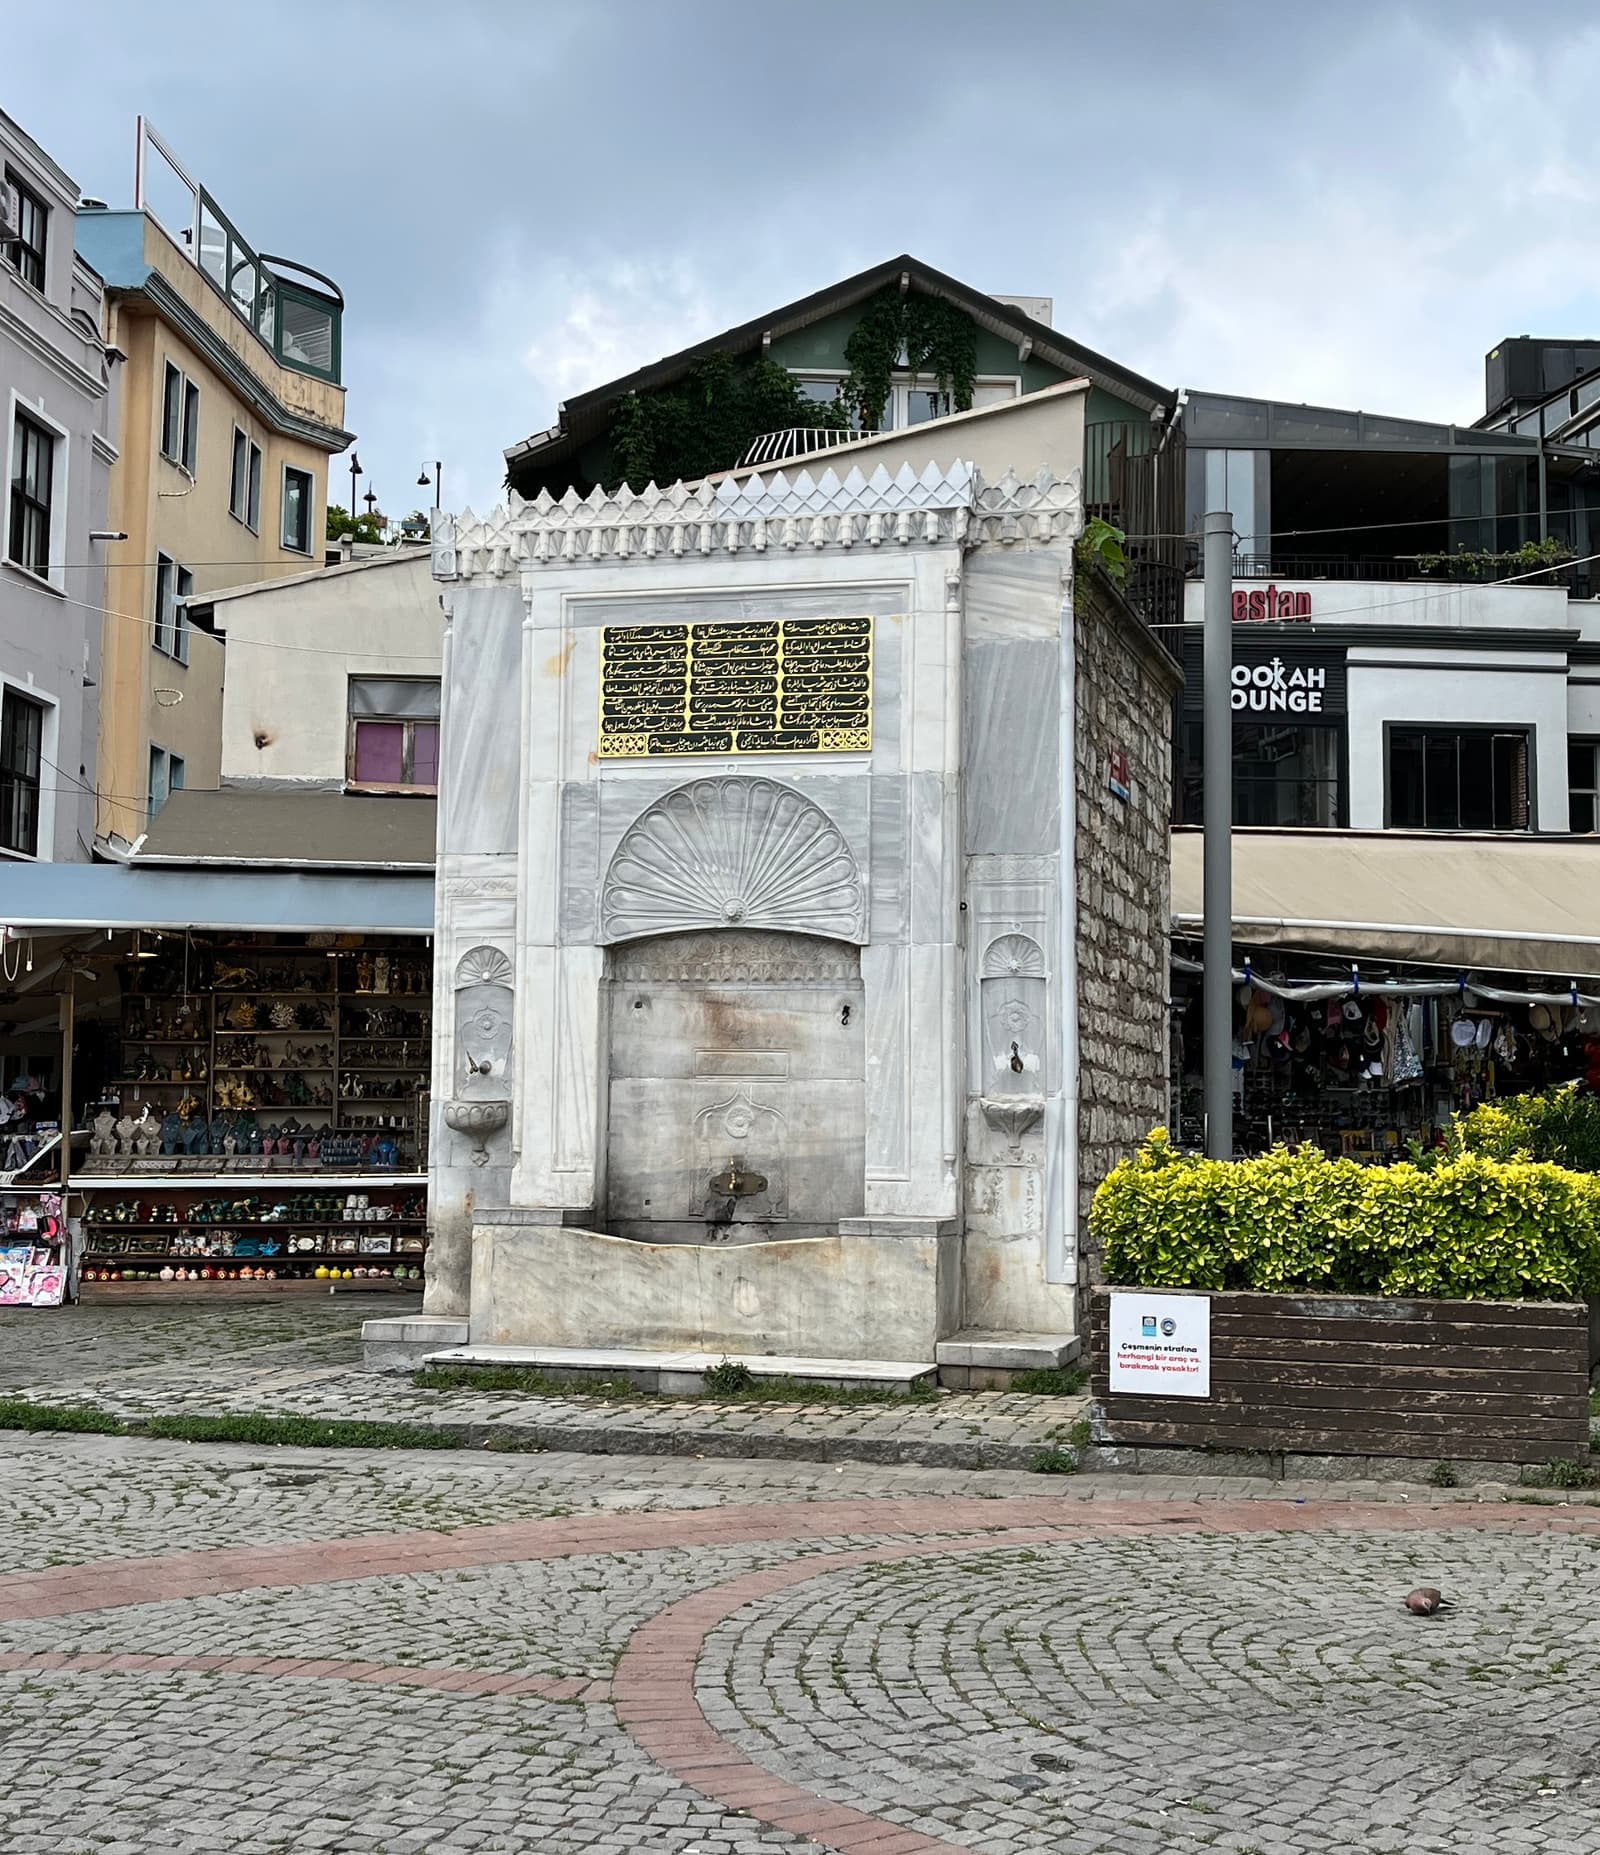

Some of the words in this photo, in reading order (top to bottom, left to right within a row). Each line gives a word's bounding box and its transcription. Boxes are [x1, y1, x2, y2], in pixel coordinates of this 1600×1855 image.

[1232, 584, 1312, 622] estan
[1231, 657, 1326, 691] OOKAH
[1231, 689, 1322, 712] OUNGE
[1121, 1342, 1162, 1351] Çeşmenin
[1164, 1345, 1198, 1353] etrafına
[1117, 1352, 1154, 1362] herhangi
[1155, 1353, 1167, 1361] bir
[1119, 1361, 1160, 1370] bırakmak
